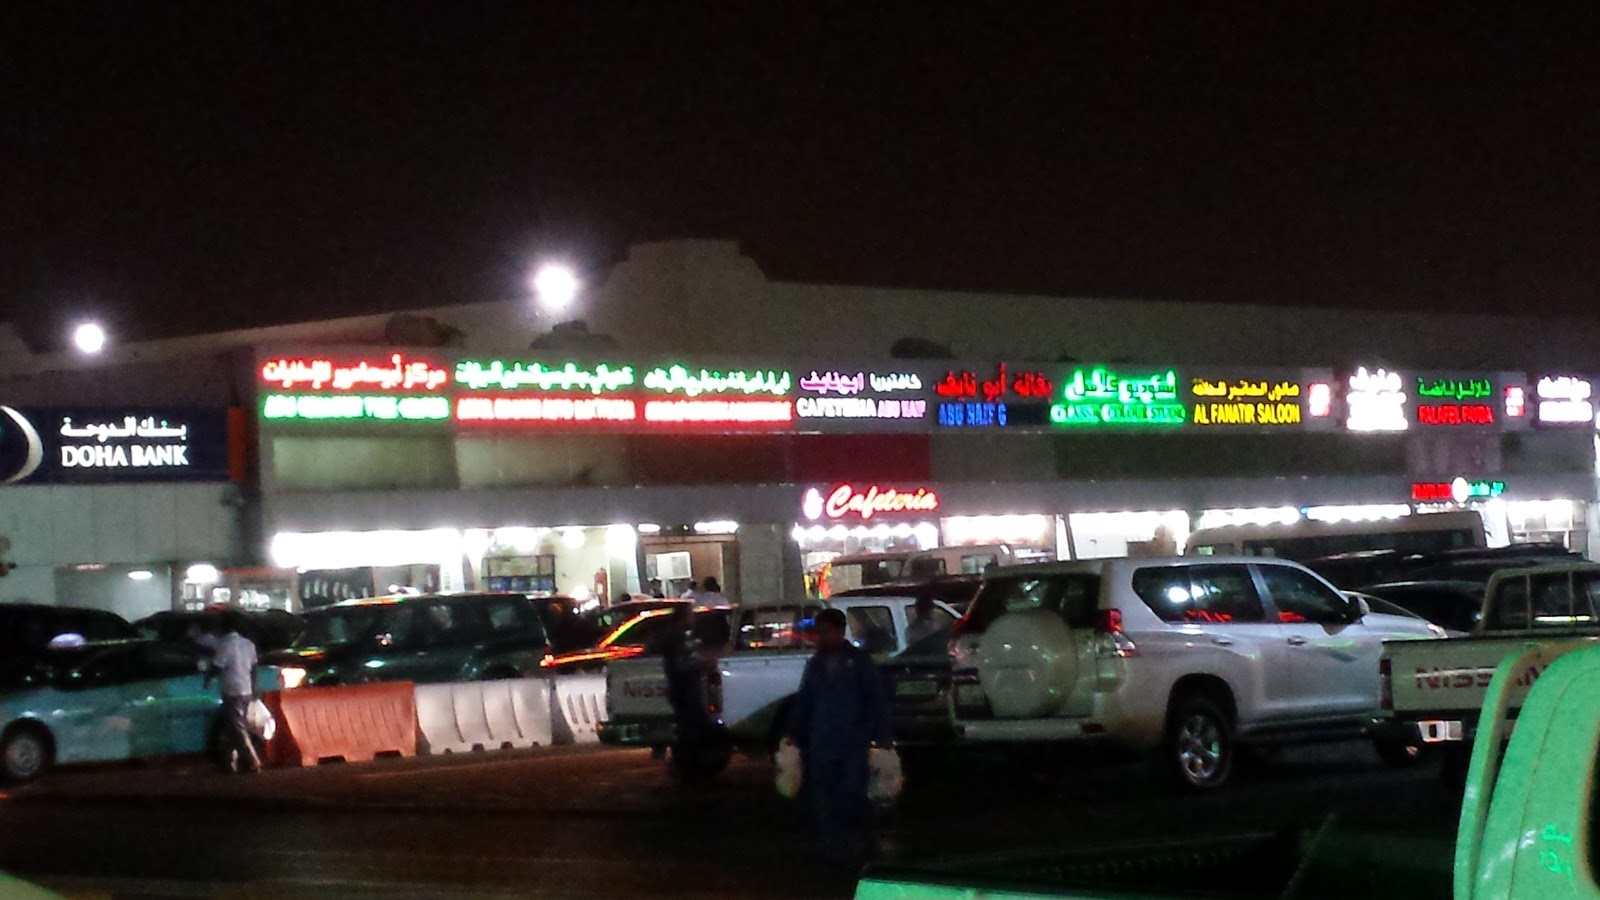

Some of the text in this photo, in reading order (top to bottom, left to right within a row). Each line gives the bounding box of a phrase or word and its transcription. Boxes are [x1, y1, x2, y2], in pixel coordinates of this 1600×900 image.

[796, 398, 877, 417] CAFETERIA
[1194, 404, 1209, 424] AL
[1257, 403, 1301, 424] SALOON
[60, 416, 187, 442] بنك الدوحة
[61, 445, 189, 467] DOHA BANK
[826, 485, 938, 519] Cafeteria
